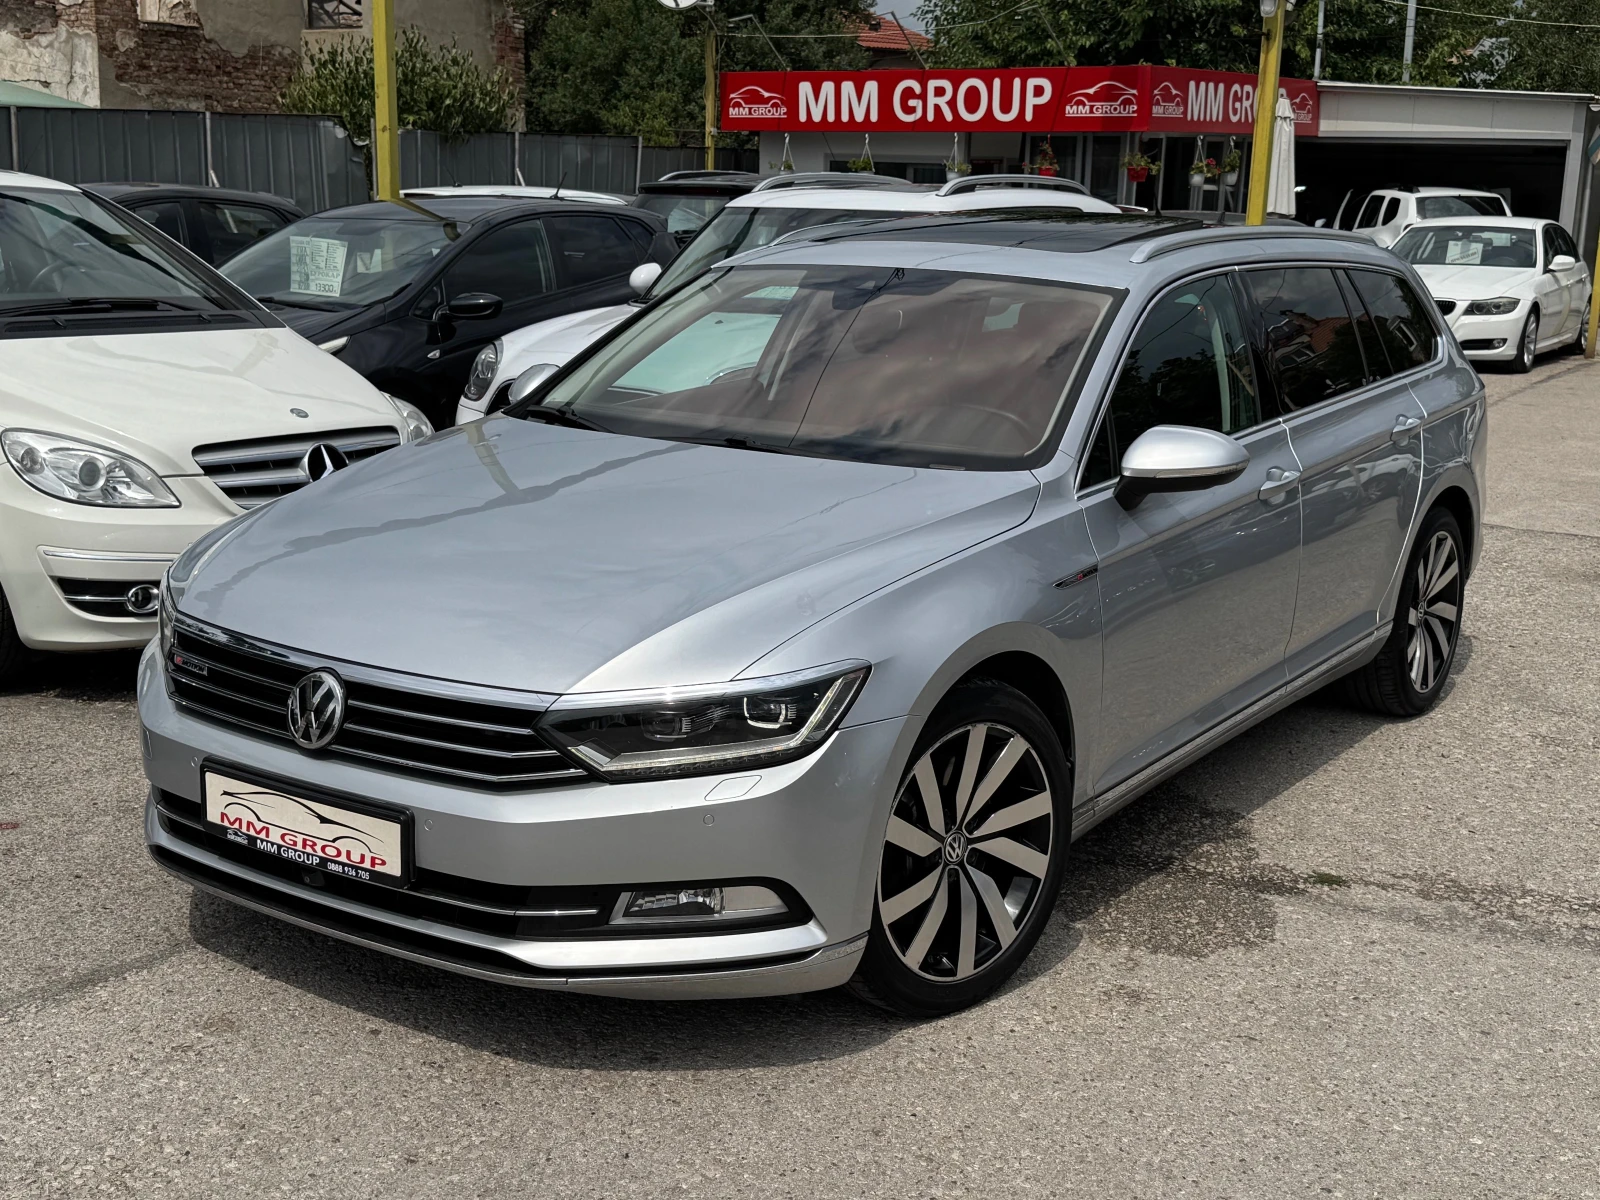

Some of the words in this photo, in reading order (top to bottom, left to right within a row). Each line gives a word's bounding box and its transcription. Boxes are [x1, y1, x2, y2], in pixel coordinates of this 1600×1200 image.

[729, 107, 749, 116] MM
[751, 107, 788, 116] GROUP
[798, 80, 879, 123] MM
[892, 77, 1053, 123] GROUP
[1065, 105, 1090, 114] MM
[1092, 105, 1138, 115] GROUP
[1152, 105, 1164, 115] MM
[1164, 105, 1184, 115] GROUP
[1186, 80, 1225, 122] MM
[220, 811, 270, 839] MM
[280, 832, 387, 869] GROUP
[256, 839, 278, 855] MM
[280, 847, 320, 866] GROUP
[327, 862, 343, 873] 0888
[344, 866, 356, 877] 936
[357, 869, 370, 880] 705
